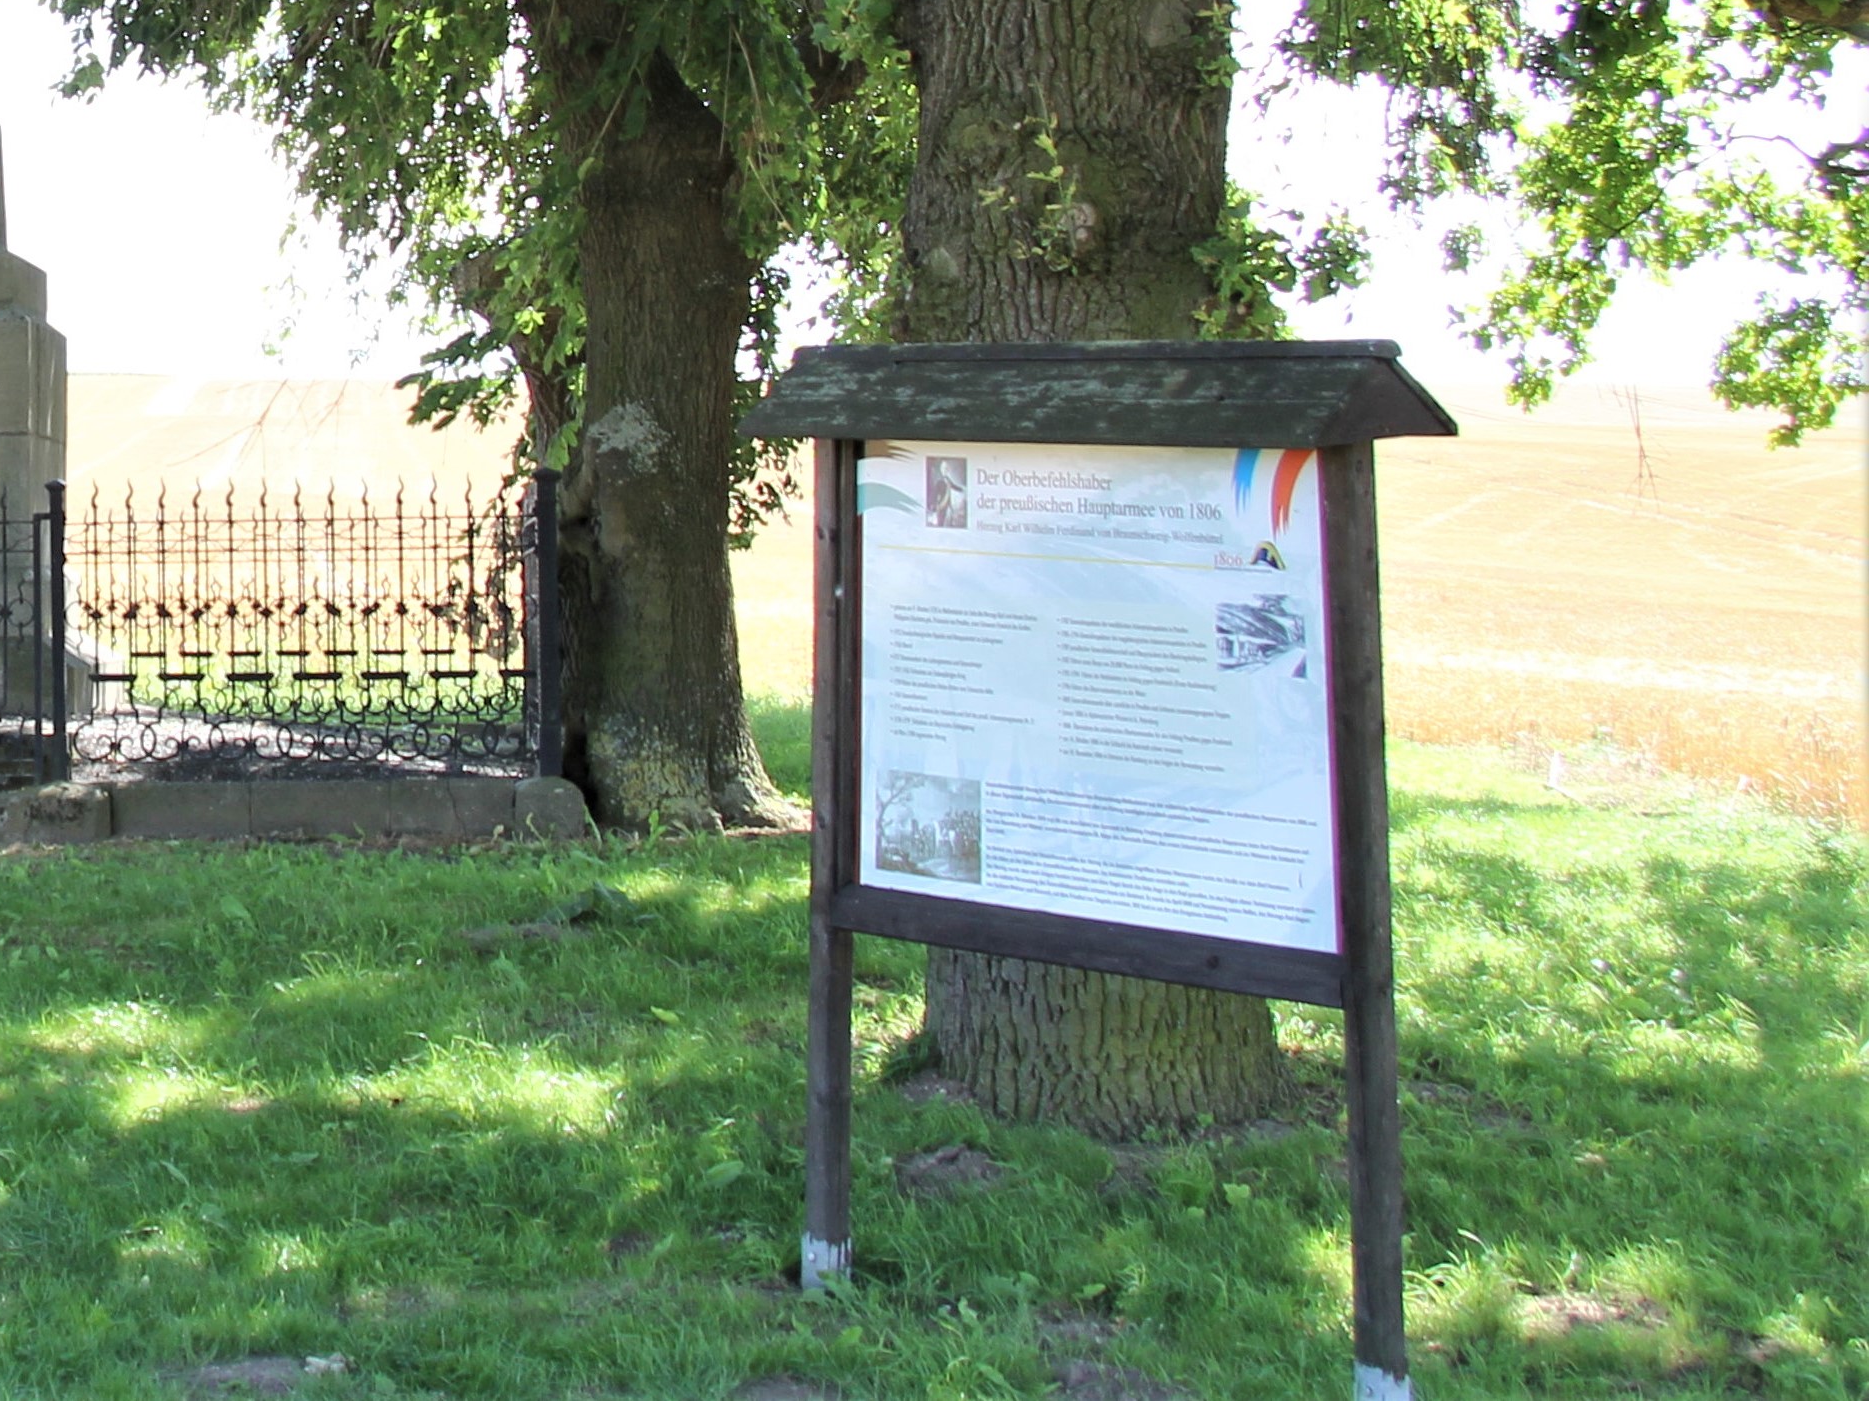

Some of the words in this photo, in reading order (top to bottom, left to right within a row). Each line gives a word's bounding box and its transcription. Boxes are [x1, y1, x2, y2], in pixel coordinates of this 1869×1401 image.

[976, 468, 999, 486] Der
[1002, 469, 1113, 491] Oberbefehlshaber
[976, 493, 997, 509] der
[999, 495, 1074, 515] preußischen
[1077, 497, 1155, 520] Hauptarmee
[1159, 505, 1185, 519] von
[1190, 502, 1222, 520] 1806
[1214, 551, 1242, 566] 1806
